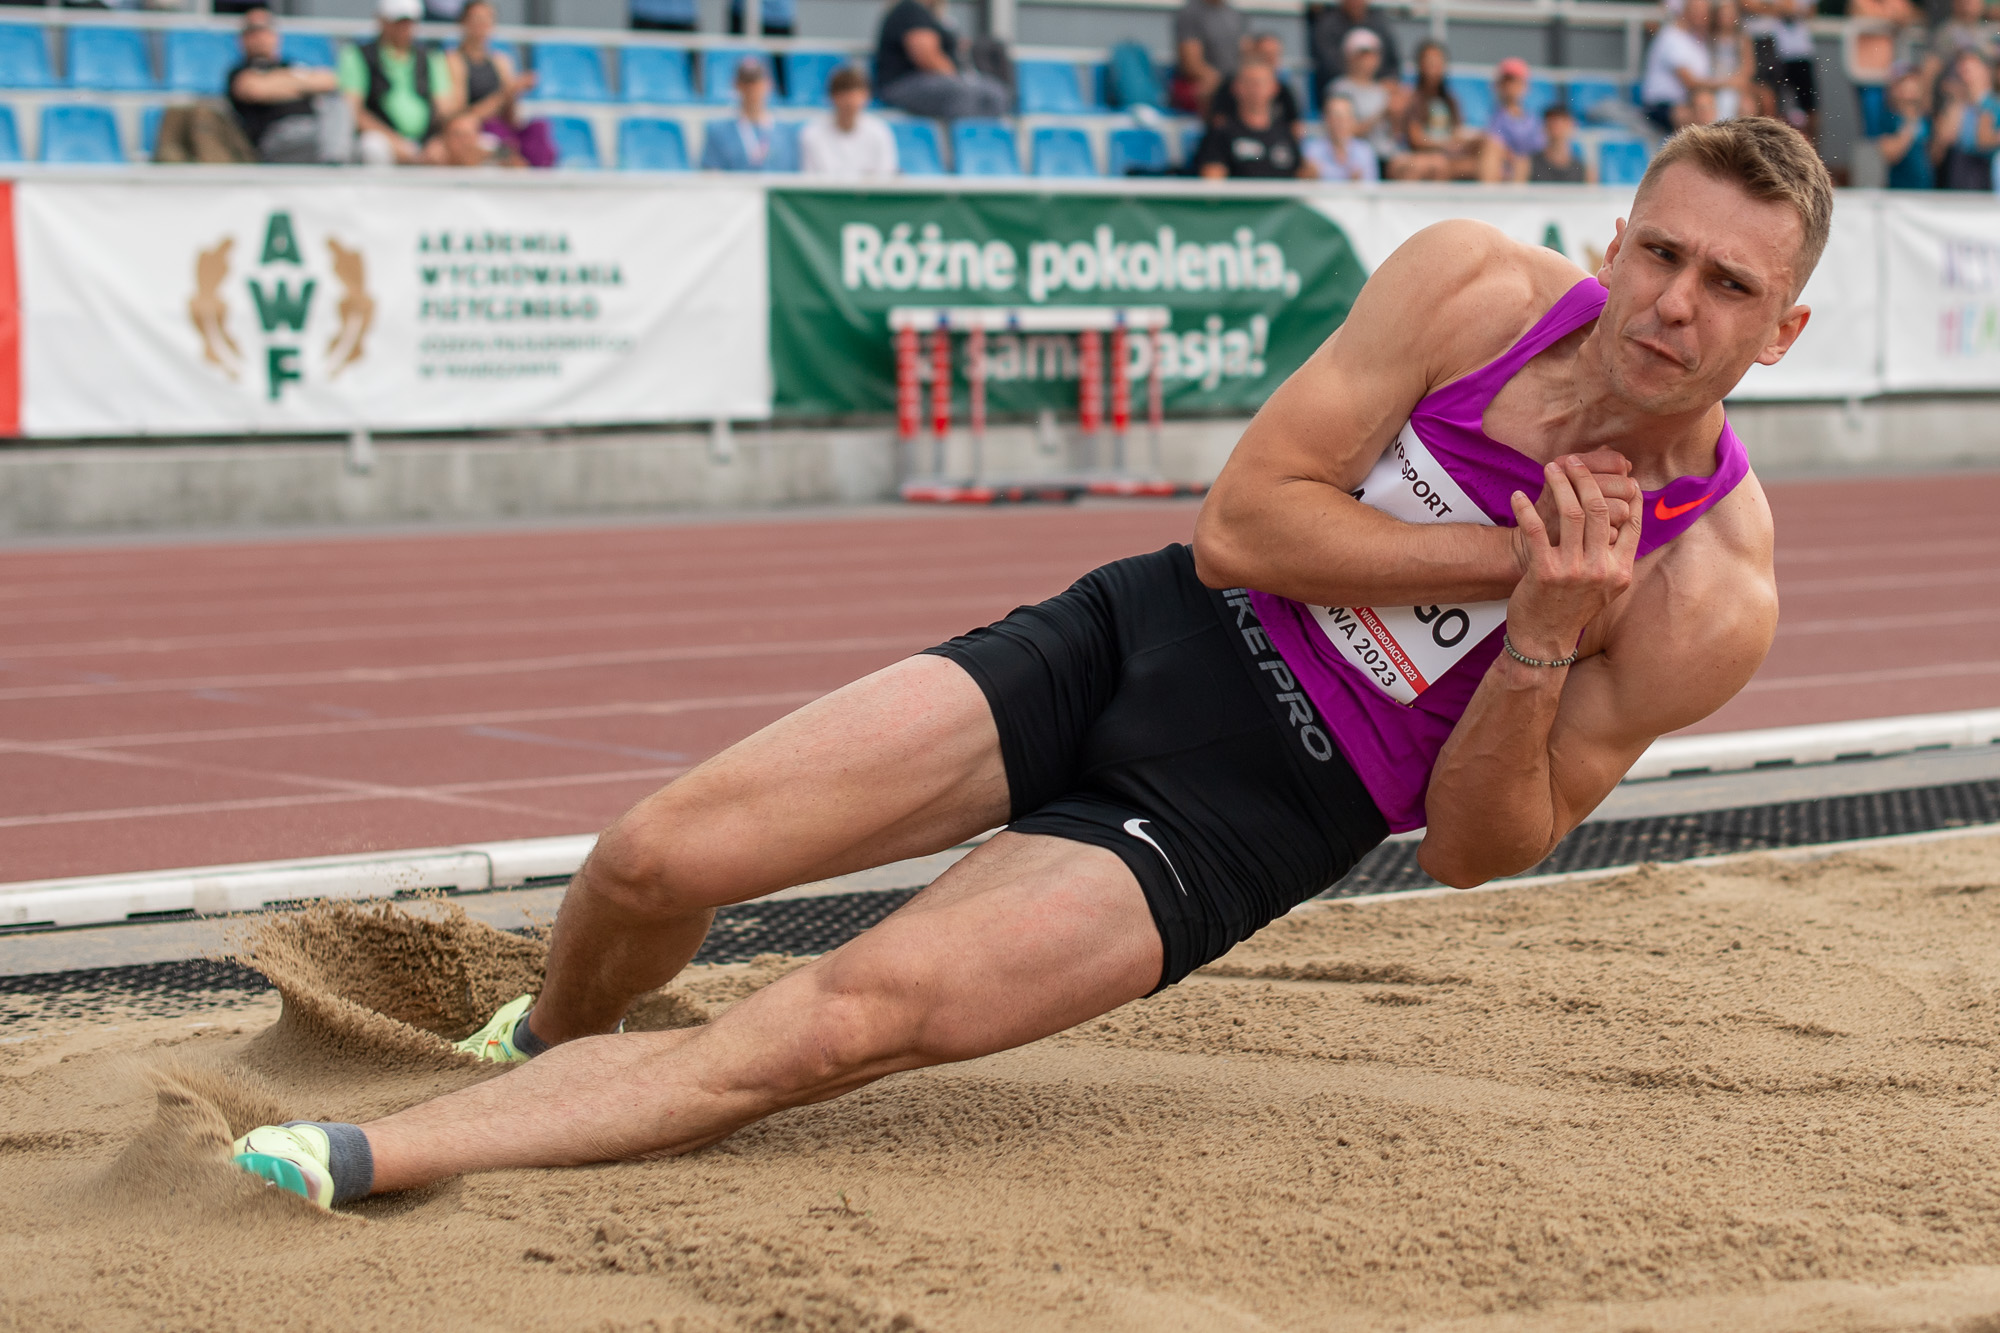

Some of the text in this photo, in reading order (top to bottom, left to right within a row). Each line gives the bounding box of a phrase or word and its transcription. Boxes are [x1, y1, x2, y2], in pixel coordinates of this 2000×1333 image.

[840, 222, 1301, 302] Różne pokolenia,
[1402, 459, 1453, 518] SPORT
[1323, 606, 1397, 687] WA 2023
[1360, 607, 1418, 682] WIELOBOJACH 2023
[1258, 660, 1332, 761] PRO
